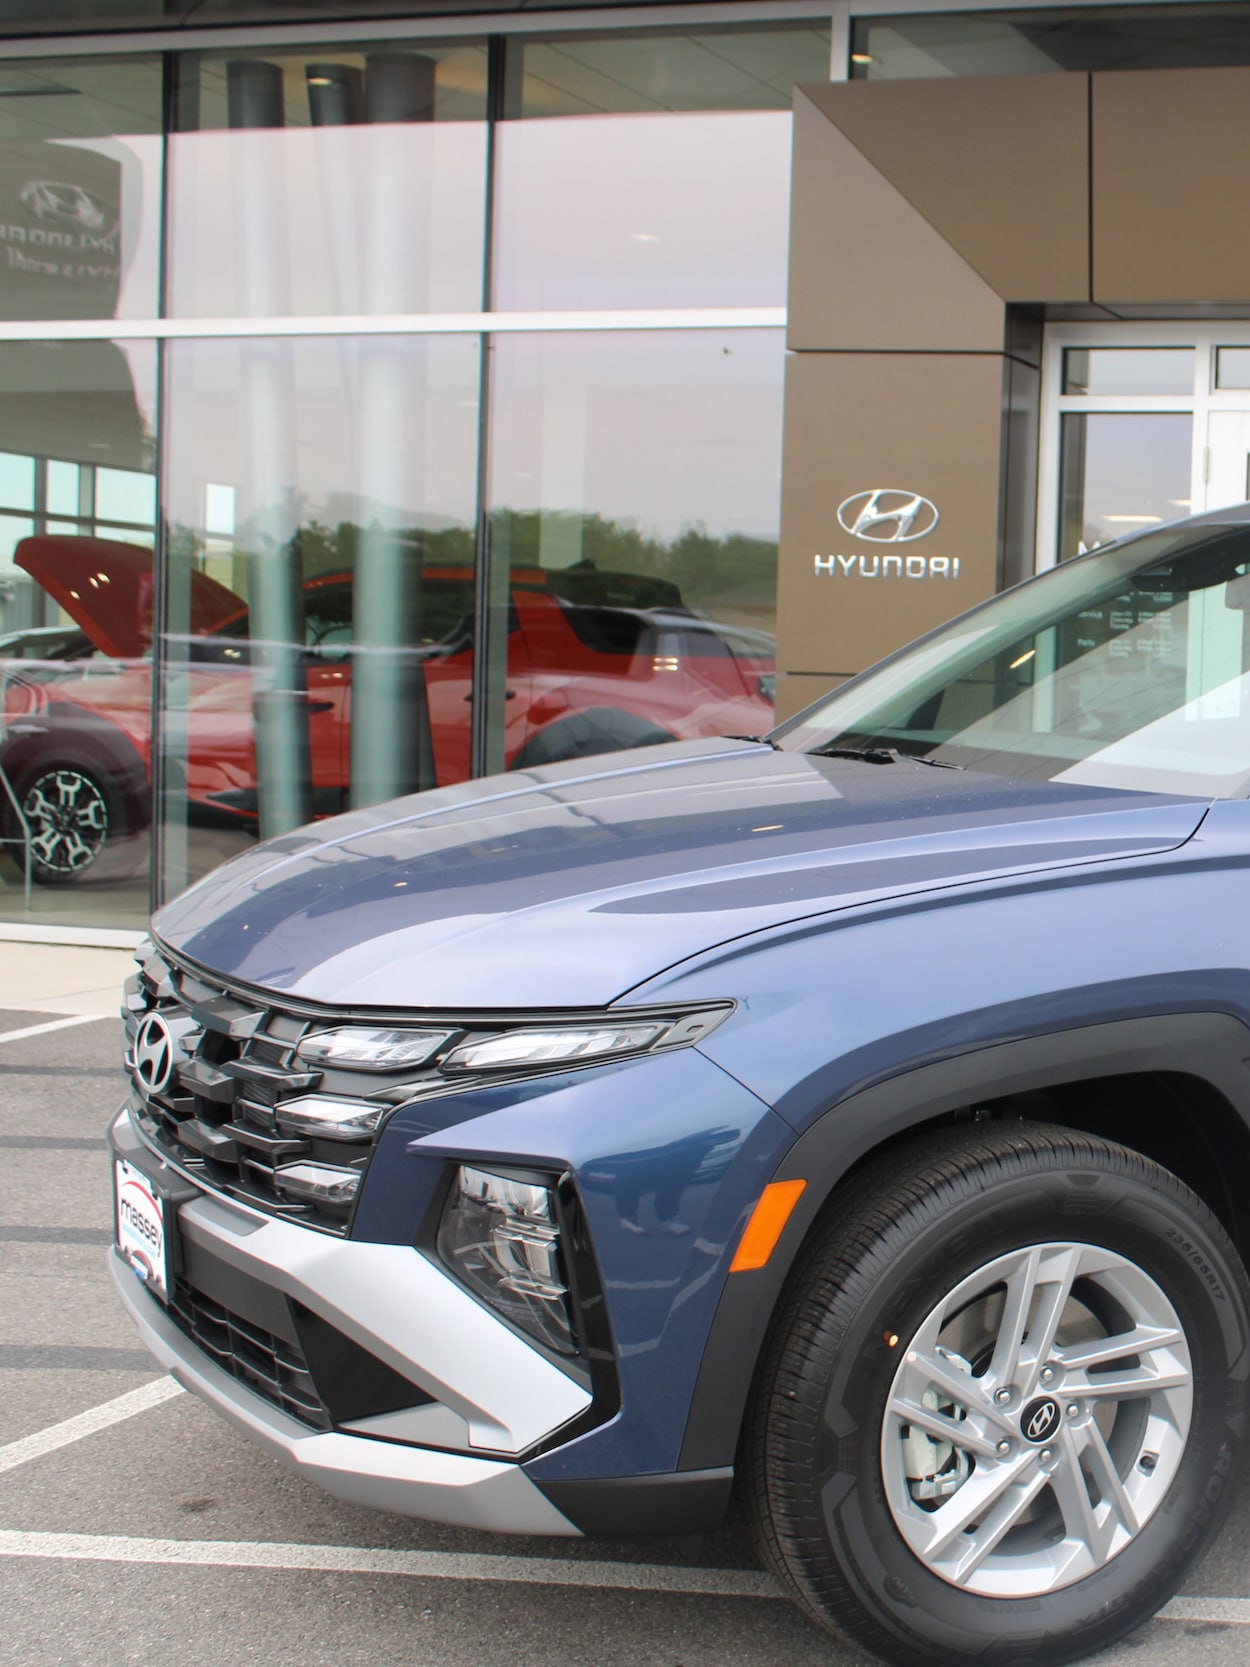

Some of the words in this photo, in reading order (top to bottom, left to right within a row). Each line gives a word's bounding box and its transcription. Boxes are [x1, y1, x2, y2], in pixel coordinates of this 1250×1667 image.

[814, 554, 960, 579] HYUNDAI
[121, 1197, 162, 1258] massey
[1164, 1227, 1226, 1302] 235/65R17
